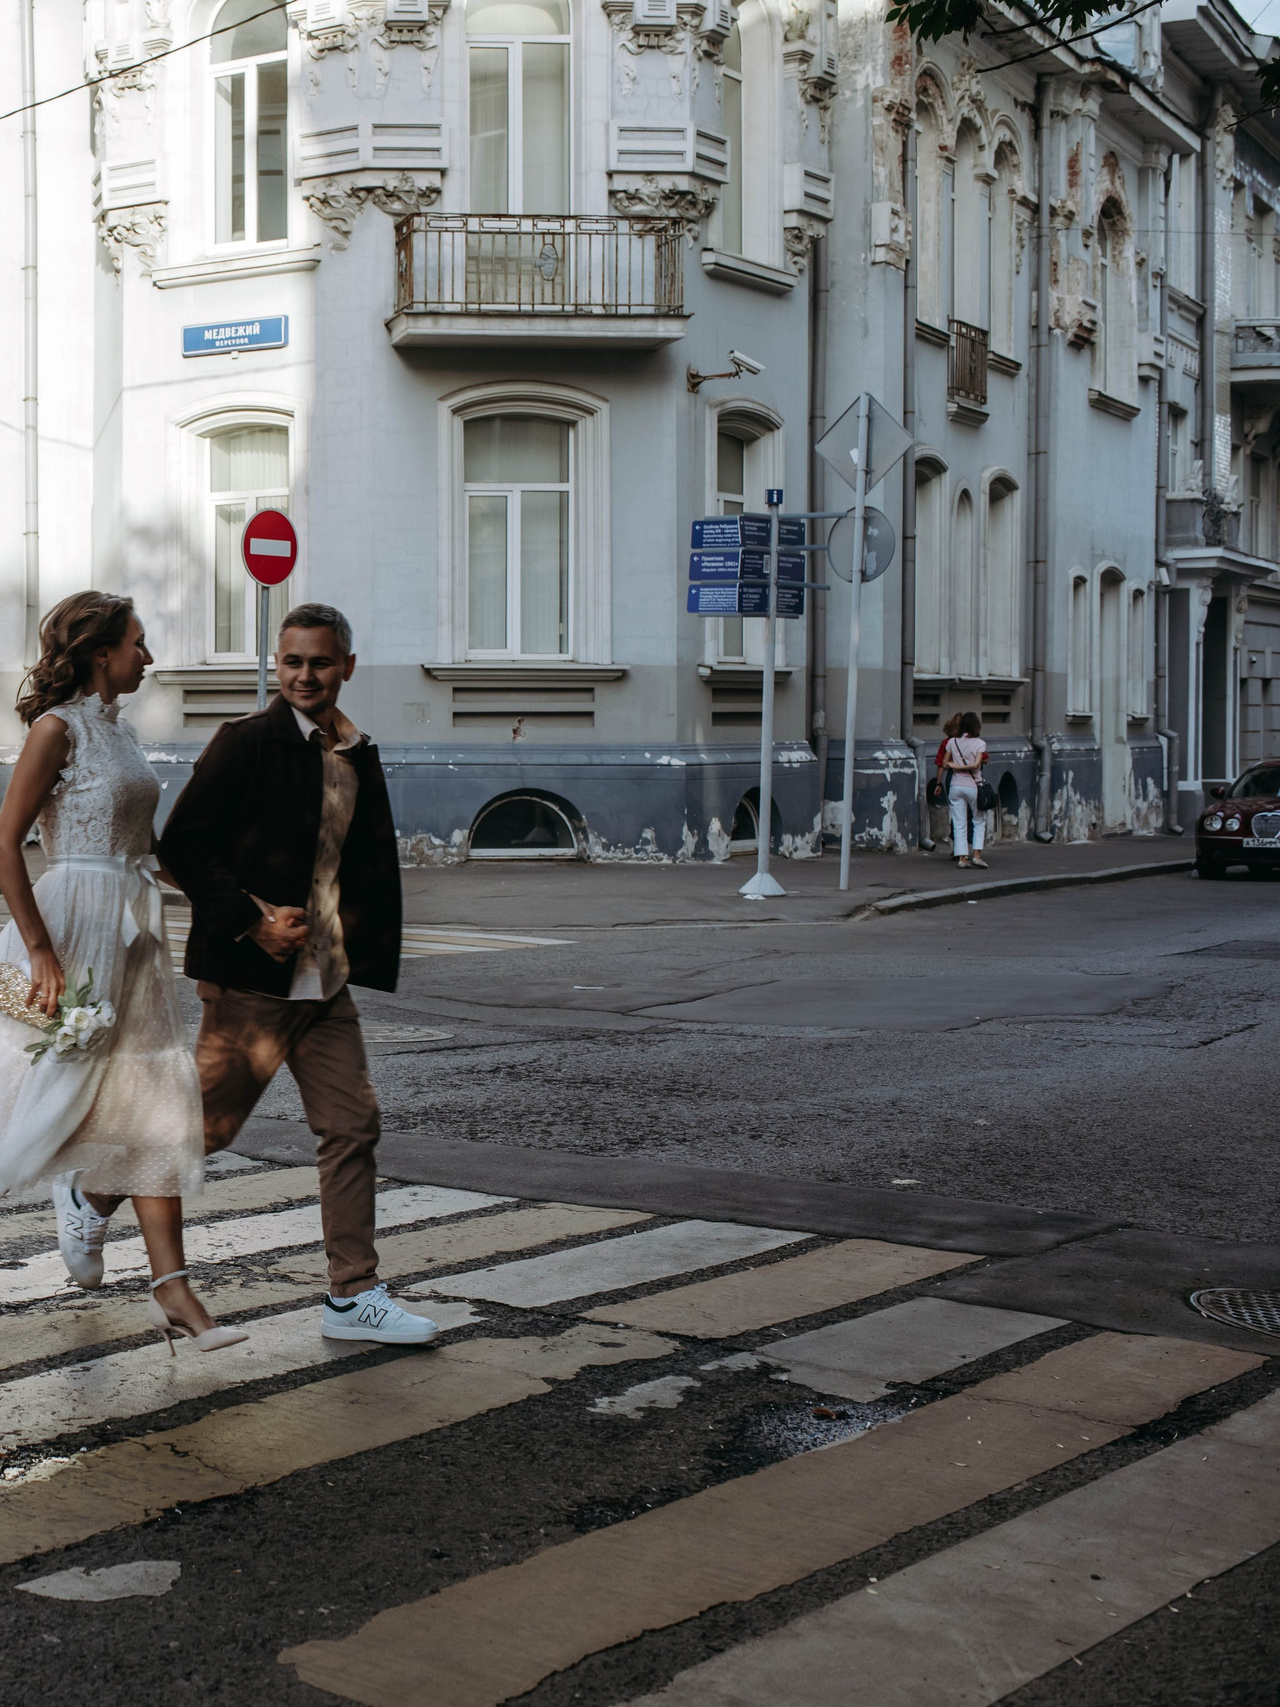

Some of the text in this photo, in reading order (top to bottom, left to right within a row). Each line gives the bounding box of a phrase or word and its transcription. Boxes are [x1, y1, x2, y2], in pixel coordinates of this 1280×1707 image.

[204, 322, 260, 341] МЕДВЕЖИЙ
[215, 338, 250, 347] ПЕРЕУЛОК
[64, 1212, 84, 1241] N
[357, 1303, 389, 1328] N
